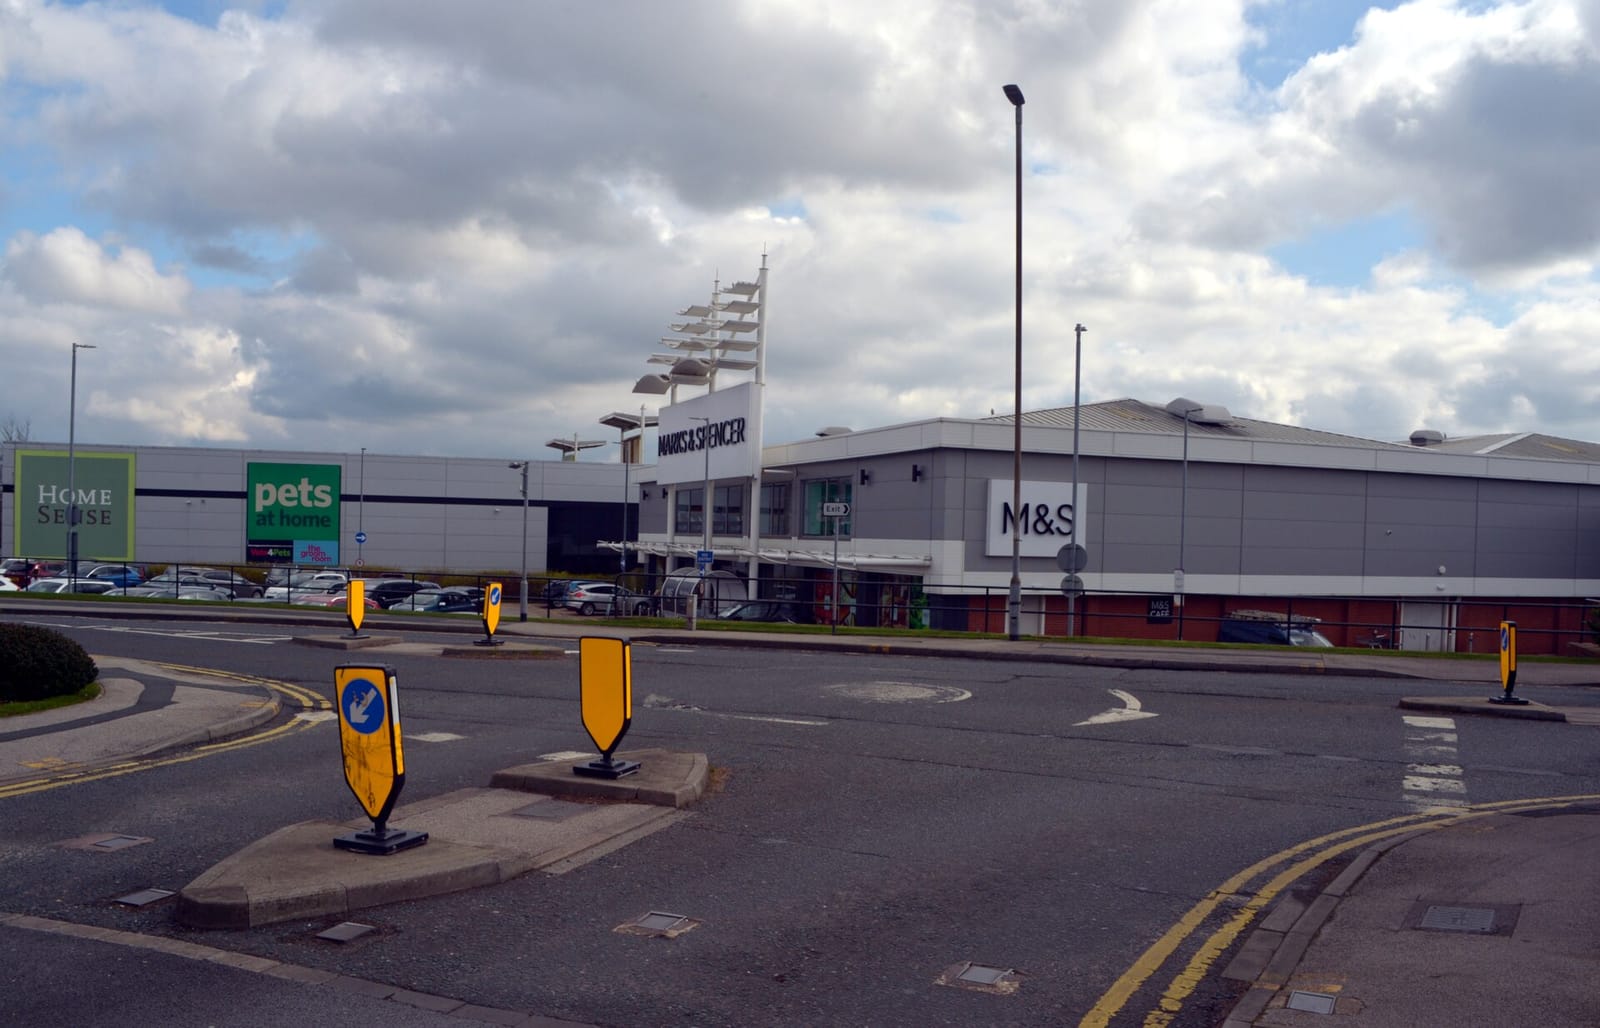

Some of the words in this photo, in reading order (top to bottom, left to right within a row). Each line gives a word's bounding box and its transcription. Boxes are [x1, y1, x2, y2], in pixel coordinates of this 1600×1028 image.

[38, 485, 112, 505] HOME
[256, 477, 332, 512] pets
[257, 512, 276, 527] at
[280, 510, 331, 528] home
[1002, 502, 1073, 536] M&S
[307, 544, 321, 552] the
[1151, 600, 1170, 610] M&S
